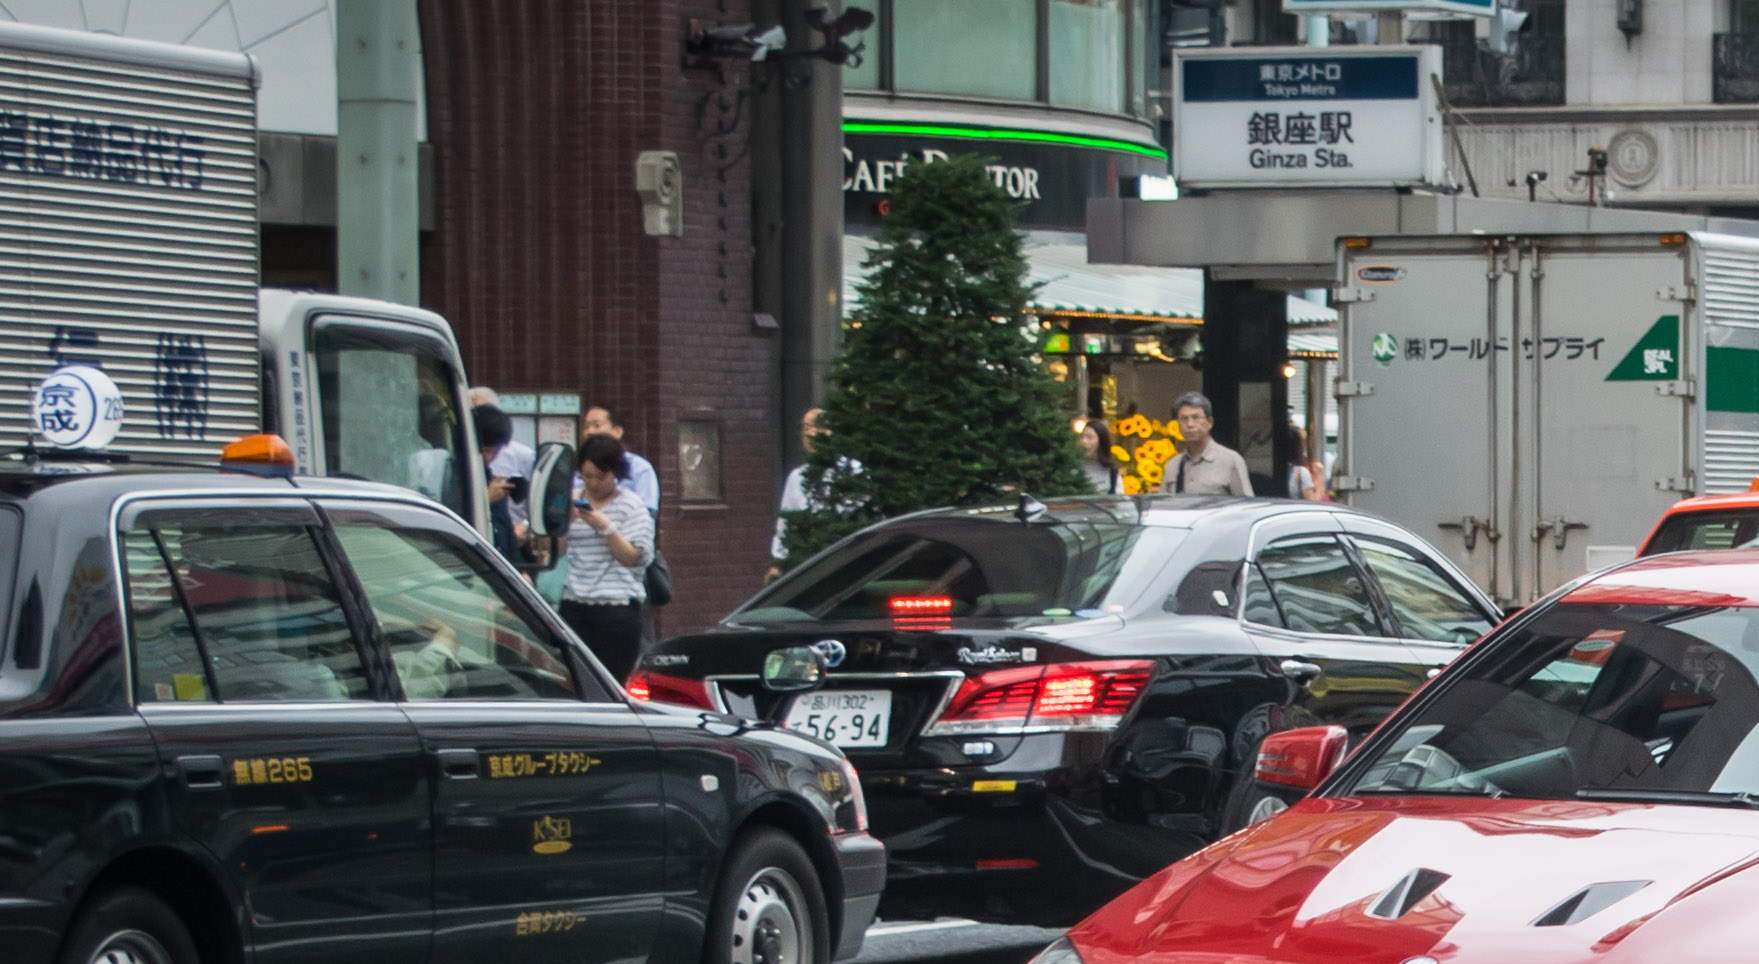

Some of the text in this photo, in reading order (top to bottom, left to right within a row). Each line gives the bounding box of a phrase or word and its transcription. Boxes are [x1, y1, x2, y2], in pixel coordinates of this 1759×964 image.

[1259, 64, 1341, 82] 東京メトロ
[1264, 83, 1336, 98] Tokyo Metro
[1247, 111, 1354, 145] 銀座駅
[1249, 148, 1353, 169] Ginza Sta.
[39, 384, 80, 433] 京成
[807, 713, 881, 741] 56-94
